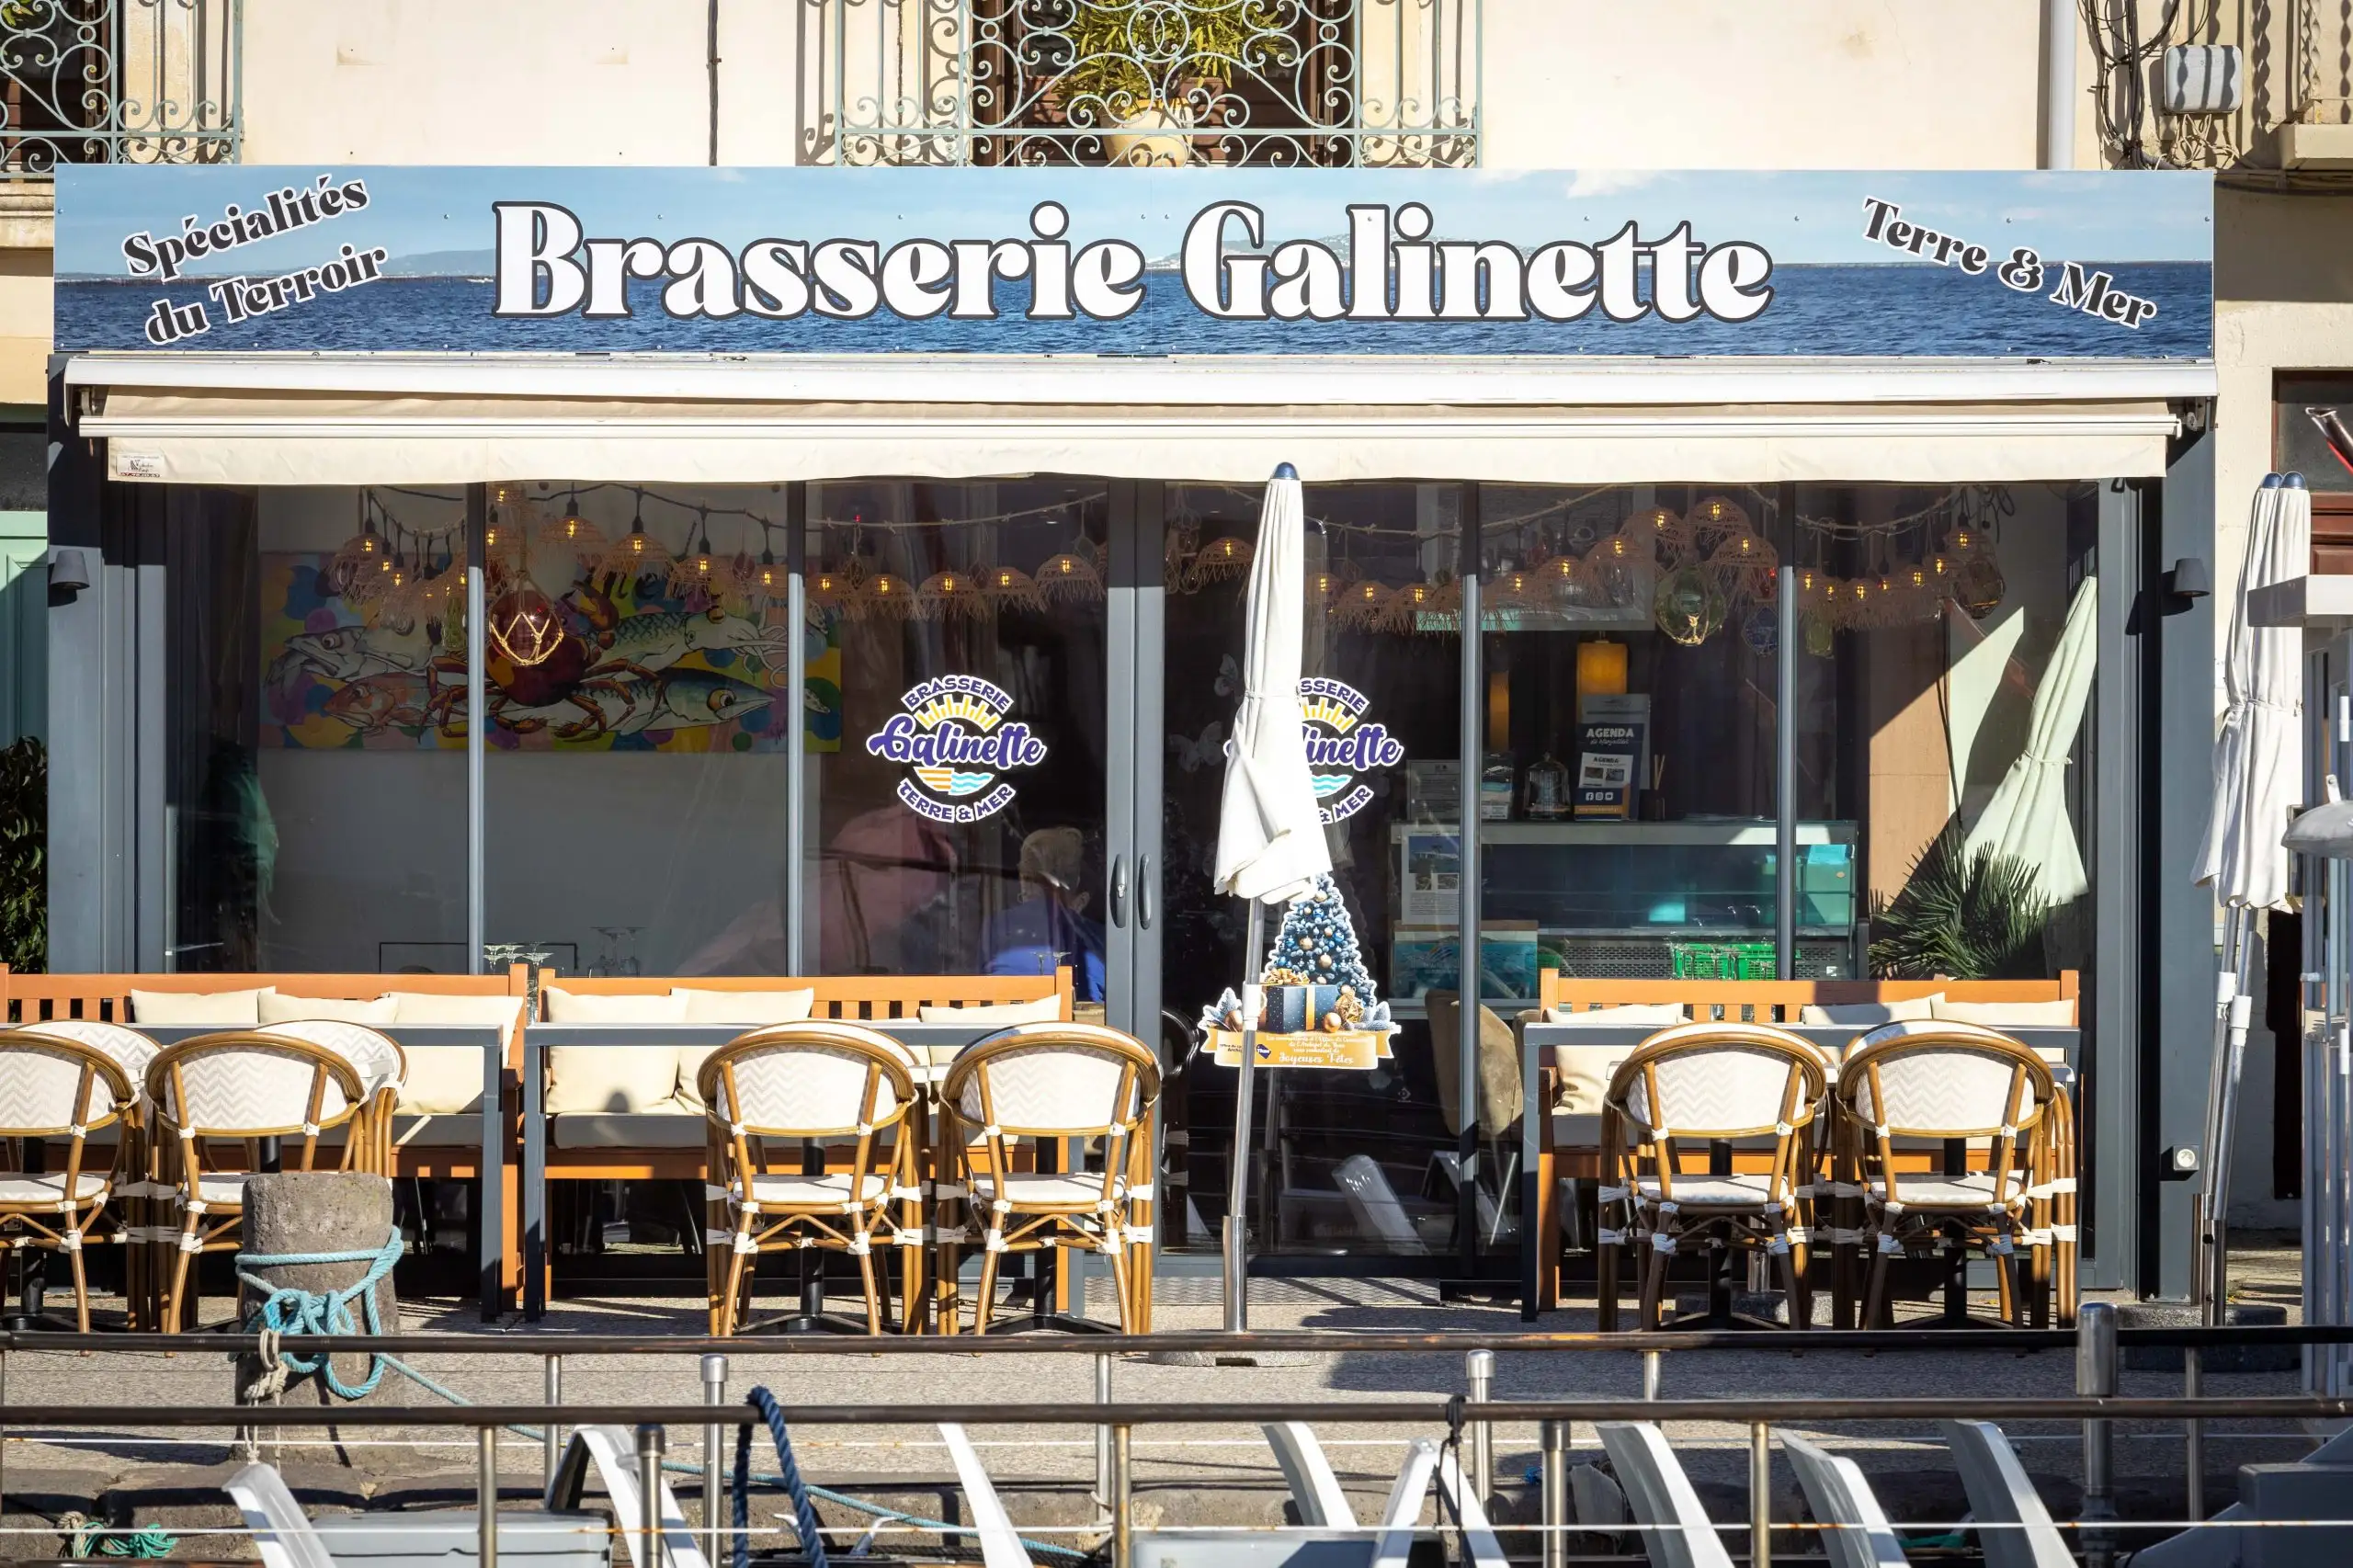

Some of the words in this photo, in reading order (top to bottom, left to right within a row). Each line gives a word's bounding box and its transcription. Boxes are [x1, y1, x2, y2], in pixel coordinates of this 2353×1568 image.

[122, 176, 369, 279] Spécialités
[492, 200, 1146, 320] Brasserie
[1181, 200, 1774, 323] Galinette
[1864, 197, 1988, 273] Terre
[1999, 248, 2043, 290] &
[2052, 263, 2155, 326] Mer
[147, 301, 209, 343] du
[210, 244, 387, 322] Terroir
[904, 676, 1011, 711] BRASSERIE
[1300, 679, 1367, 712] SSERIE
[868, 714, 1046, 768] Galinette
[1586, 728, 1634, 737] AGENDA
[899, 780, 953, 821] TERRE
[958, 807, 972, 820] &
[976, 785, 1014, 819] MER
[1334, 787, 1371, 819] MER
